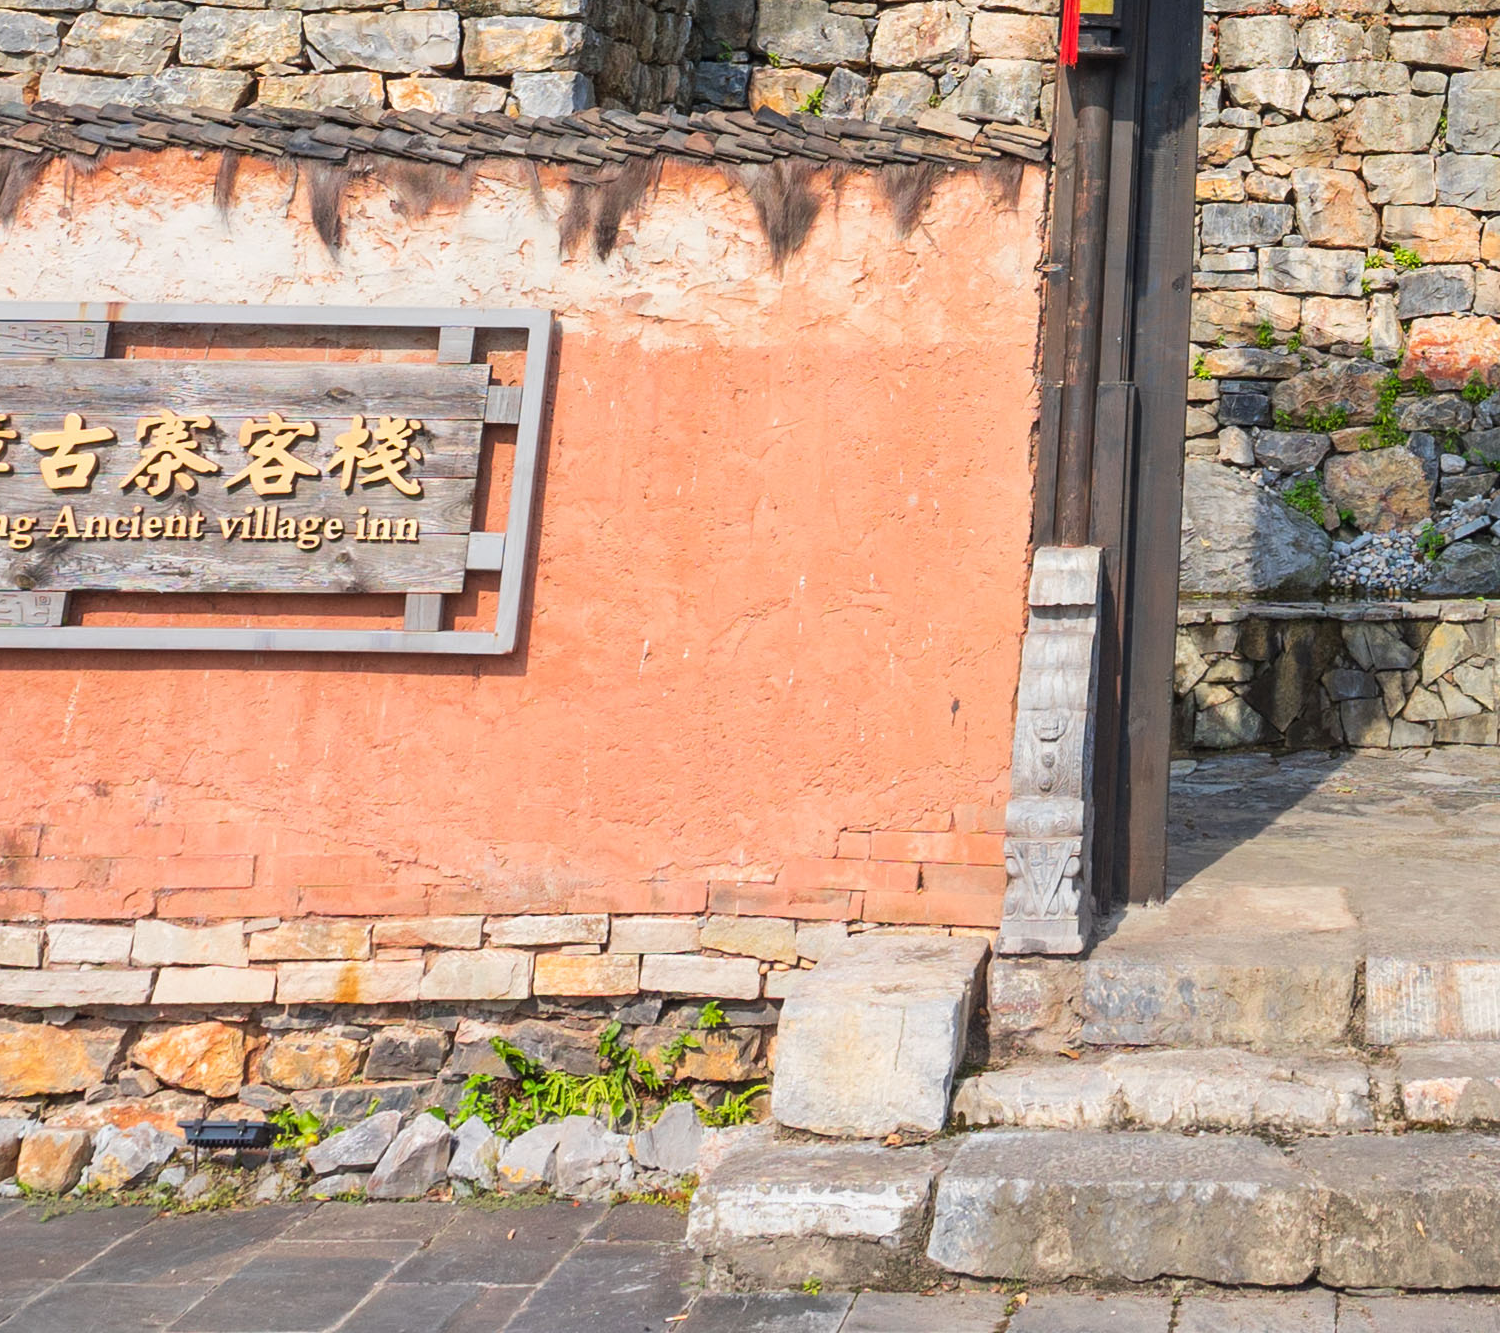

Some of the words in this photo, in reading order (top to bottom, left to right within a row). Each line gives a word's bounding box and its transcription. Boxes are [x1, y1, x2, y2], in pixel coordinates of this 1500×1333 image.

[46, 505, 205, 539] Ancient
[218, 505, 344, 550] village
[354, 505, 420, 542] inn
